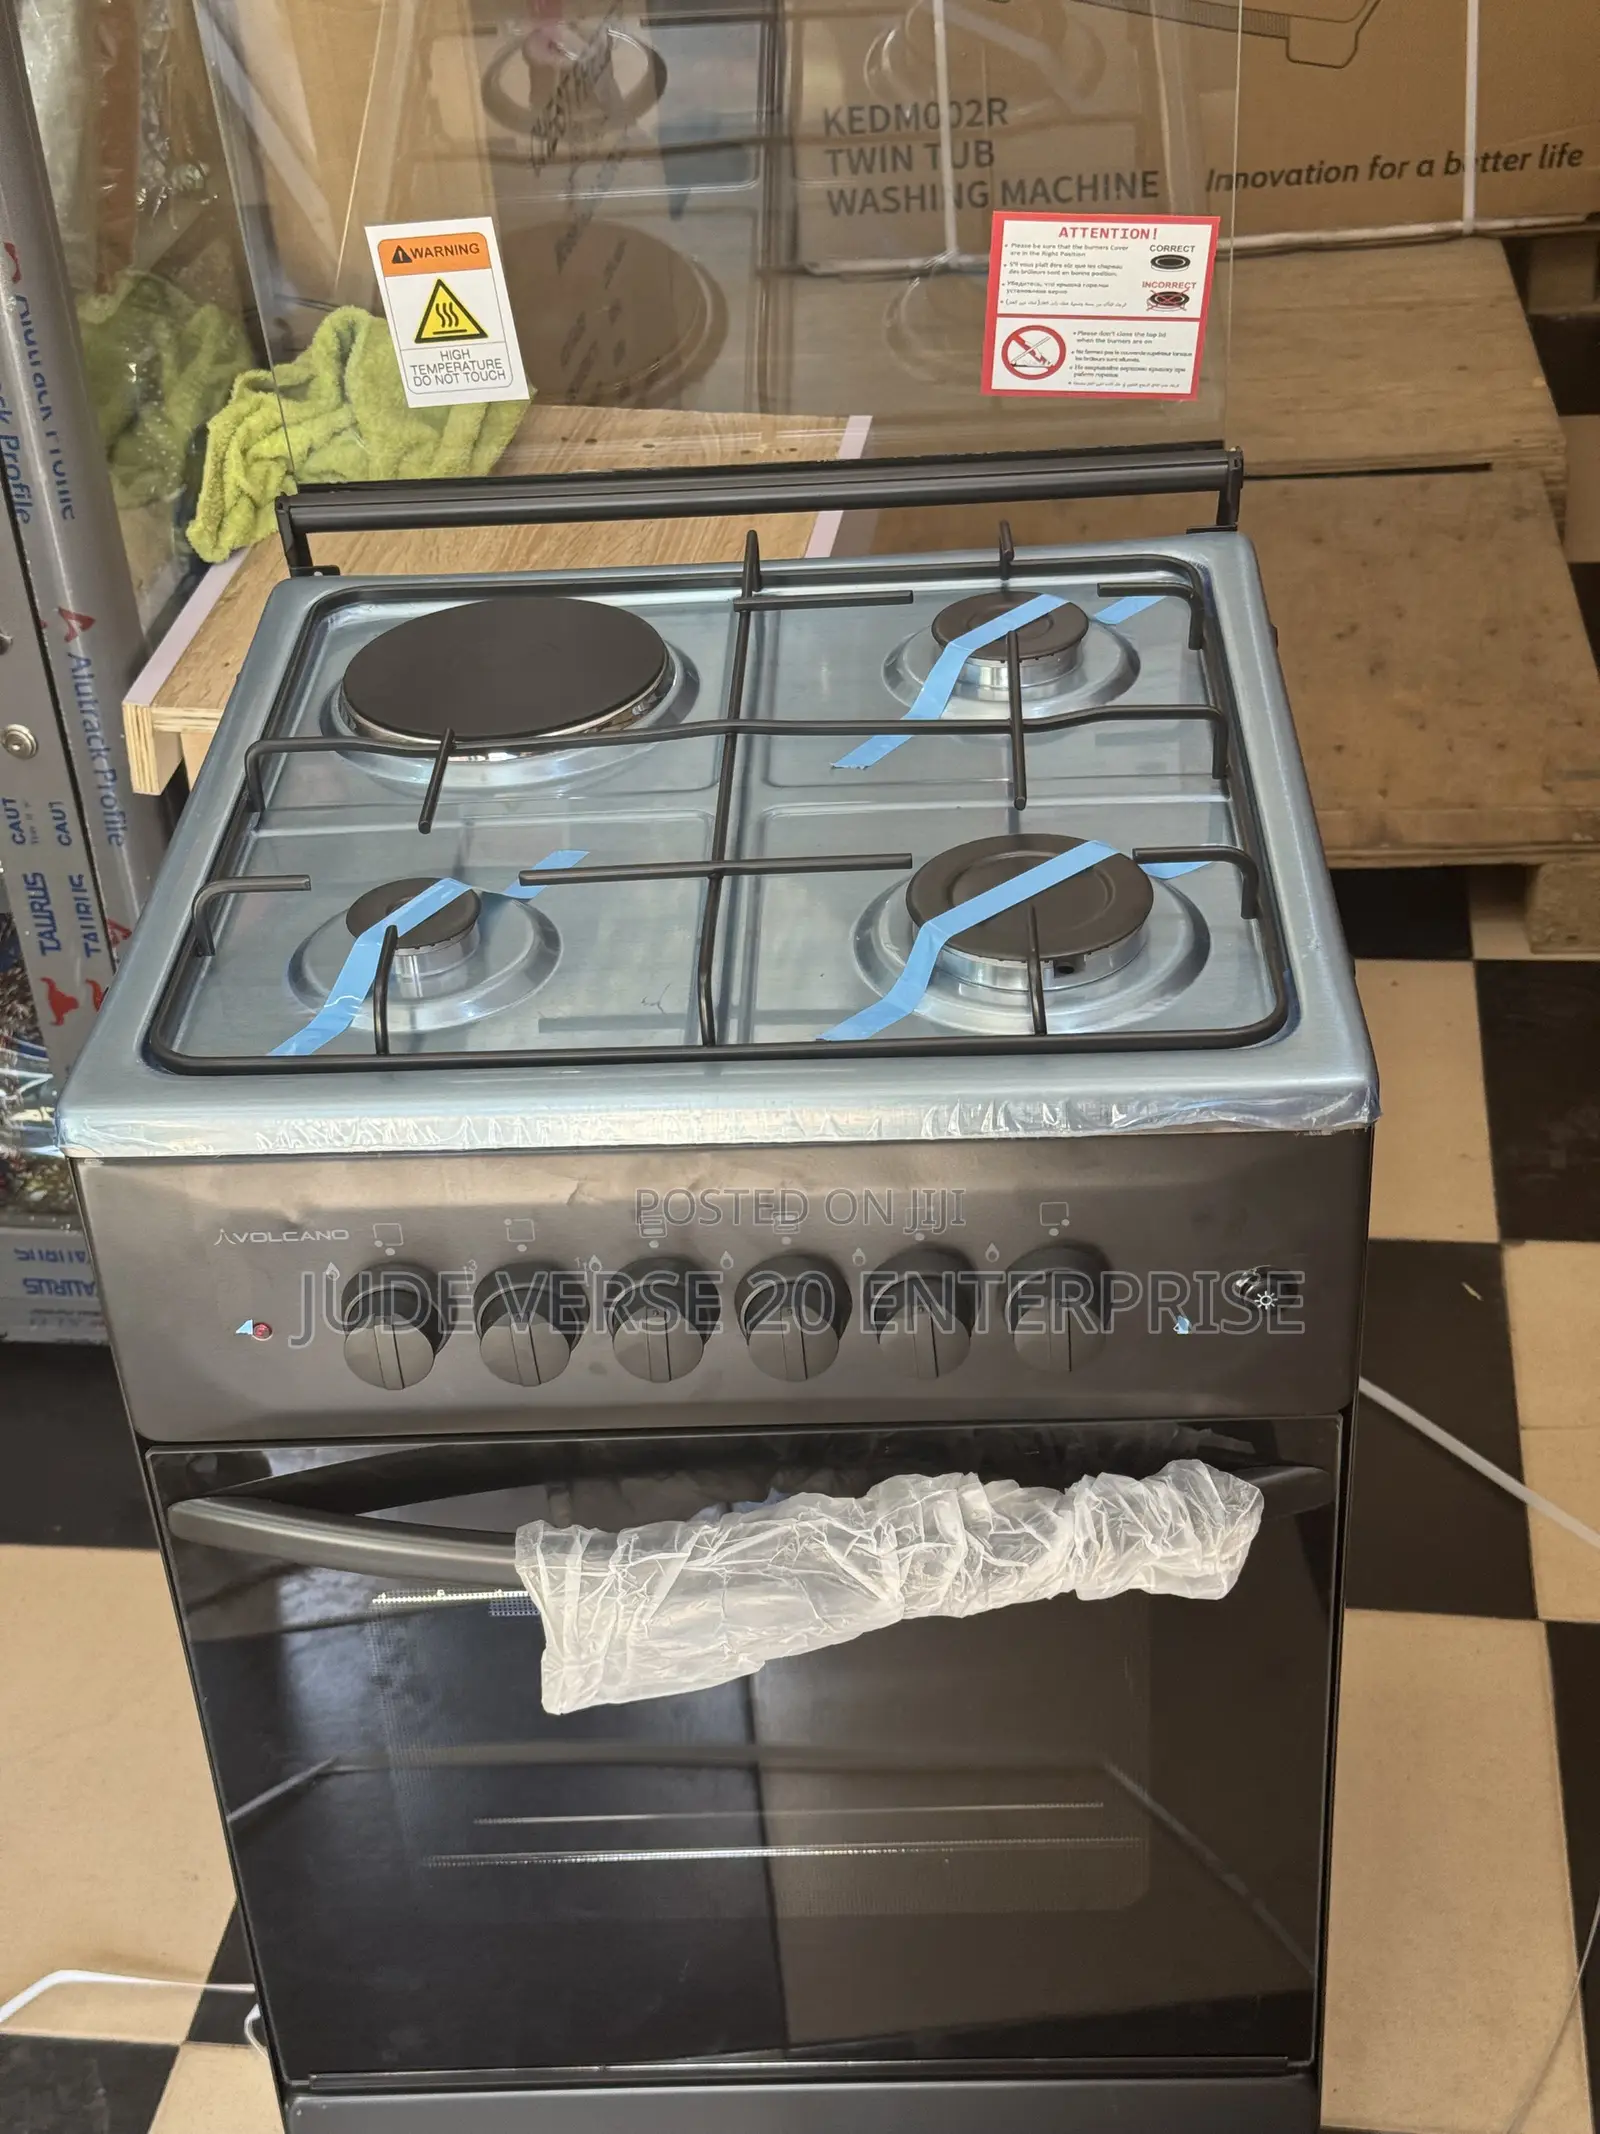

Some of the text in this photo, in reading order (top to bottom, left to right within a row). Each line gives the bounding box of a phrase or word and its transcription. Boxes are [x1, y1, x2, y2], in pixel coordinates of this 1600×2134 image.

[823, 98, 1009, 137] KEDM002R
[824, 139, 996, 176] TWIN TUB
[1204, 142, 1584, 193] Innovation for a btter life
[826, 170, 1160, 217] WASHING MACHINE
[1058, 225, 1158, 241] ATTENTION!
[409, 243, 480, 260] WARNING
[1149, 244, 1196, 253] CORRECT
[1142, 281, 1197, 290] INCORRECT
[440, 349, 471, 361] HIGH
[410, 358, 503, 376] TEMPERATURE
[413, 369, 506, 387] DO NOT TOUCH
[68, 652, 129, 847] Alutrack Profile
[22, 872, 62, 957] TAURUS
[233, 1228, 350, 1244] VOLCANO
